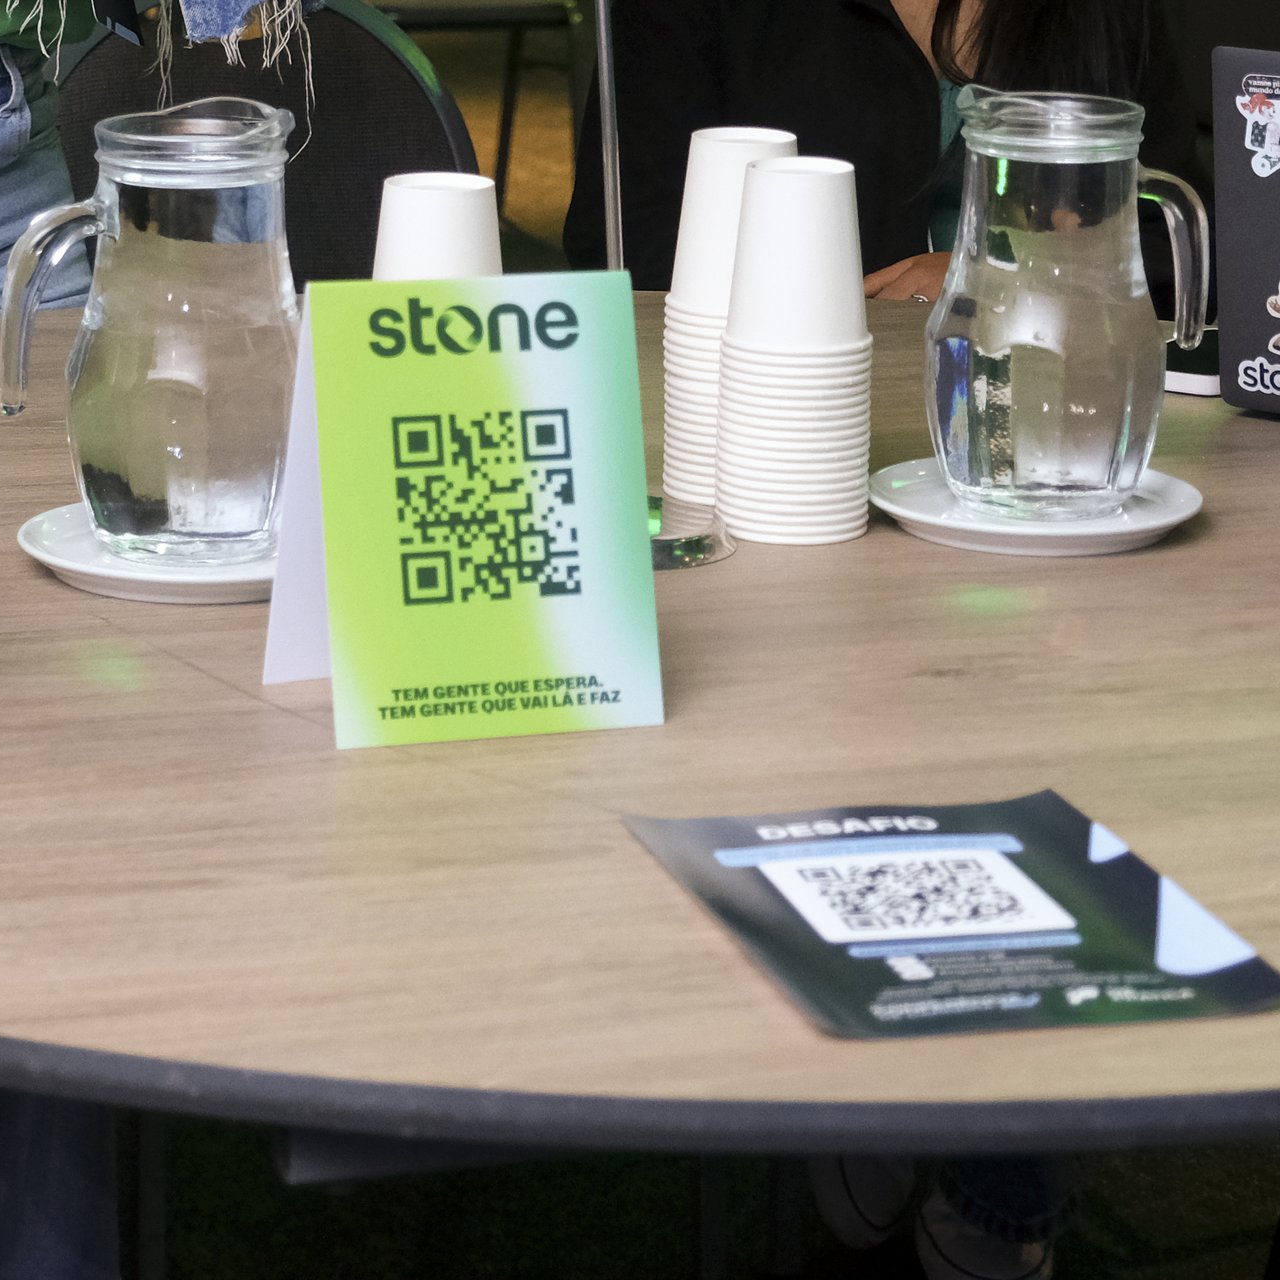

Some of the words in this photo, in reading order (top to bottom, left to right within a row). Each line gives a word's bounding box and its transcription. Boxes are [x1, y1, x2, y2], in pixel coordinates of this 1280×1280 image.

[369, 297, 580, 358] stone
[392, 688, 429, 702] TEM
[433, 683, 491, 699] GENTE
[494, 679, 530, 696] QUE
[533, 675, 604, 691] ESPERA.
[379, 705, 416, 720] TEM
[420, 701, 478, 718] GENTE
[481, 696, 517, 714] QUE
[520, 694, 549, 710] VAI
[577, 693, 588, 706] E
[591, 690, 622, 704] FAZ
[756, 815, 939, 840] DESAFIO
